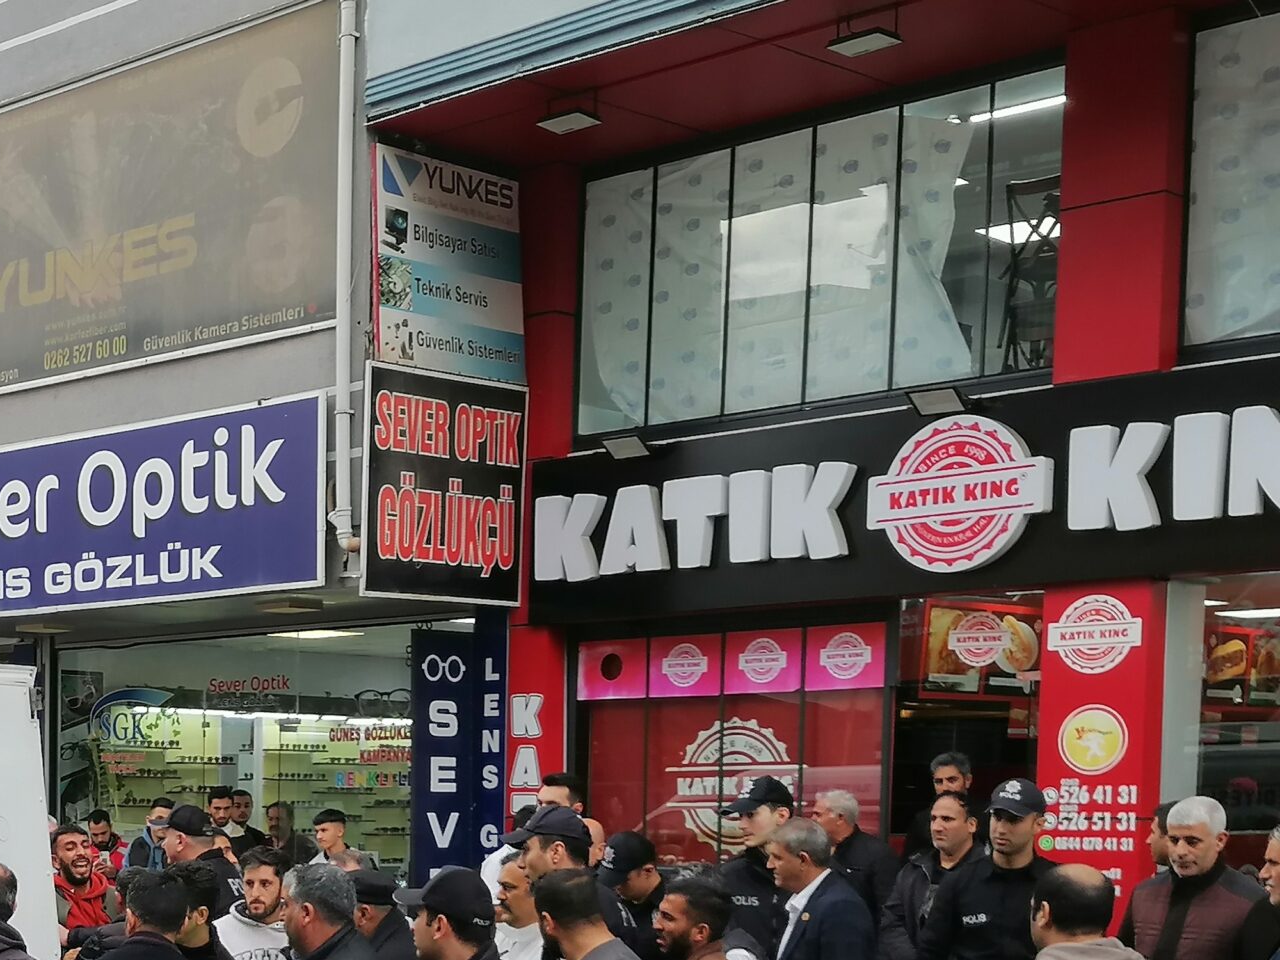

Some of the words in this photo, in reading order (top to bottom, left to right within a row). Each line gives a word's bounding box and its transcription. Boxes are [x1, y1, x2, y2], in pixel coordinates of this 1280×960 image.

[424, 162, 513, 209] YUNKES
[413, 224, 467, 253] Bilgisayar
[414, 277, 452, 300] Teknik
[455, 286, 488, 308] Servis
[144, 330, 192, 352] Güvenlik
[194, 321, 239, 341] Kamera
[242, 306, 305, 331] Sistemleri
[416, 330, 465, 355] Güvenlik
[44, 347, 70, 371] 0262
[73, 341, 93, 365] 527
[96, 338, 110, 360] 60
[112, 335, 128, 356] 00
[375, 388, 450, 460] SEVER
[77, 424, 286, 539] Optik
[889, 485, 956, 510] KATIK
[964, 477, 1020, 501] KING
[376, 471, 515, 578] GÖZLÜKÇÜ
[534, 461, 857, 583] KATIK
[44, 542, 223, 596] GÖZLÜK
[1060, 630, 1096, 642] KATIK
[1099, 628, 1129, 640] KING
[209, 678, 247, 693] Sever
[250, 674, 290, 692] Optik
[100, 711, 148, 741] SGK
[329, 724, 361, 745] GÜNEŞ
[481, 657, 500, 790] LENS
[426, 700, 460, 880] SEV
[1059, 784, 1090, 805] 526
[1092, 785, 1112, 804] 41
[1117, 785, 1137, 804] 31
[1058, 811, 1089, 831] 526
[1091, 811, 1111, 831] 51
[1116, 812, 1136, 831] 31
